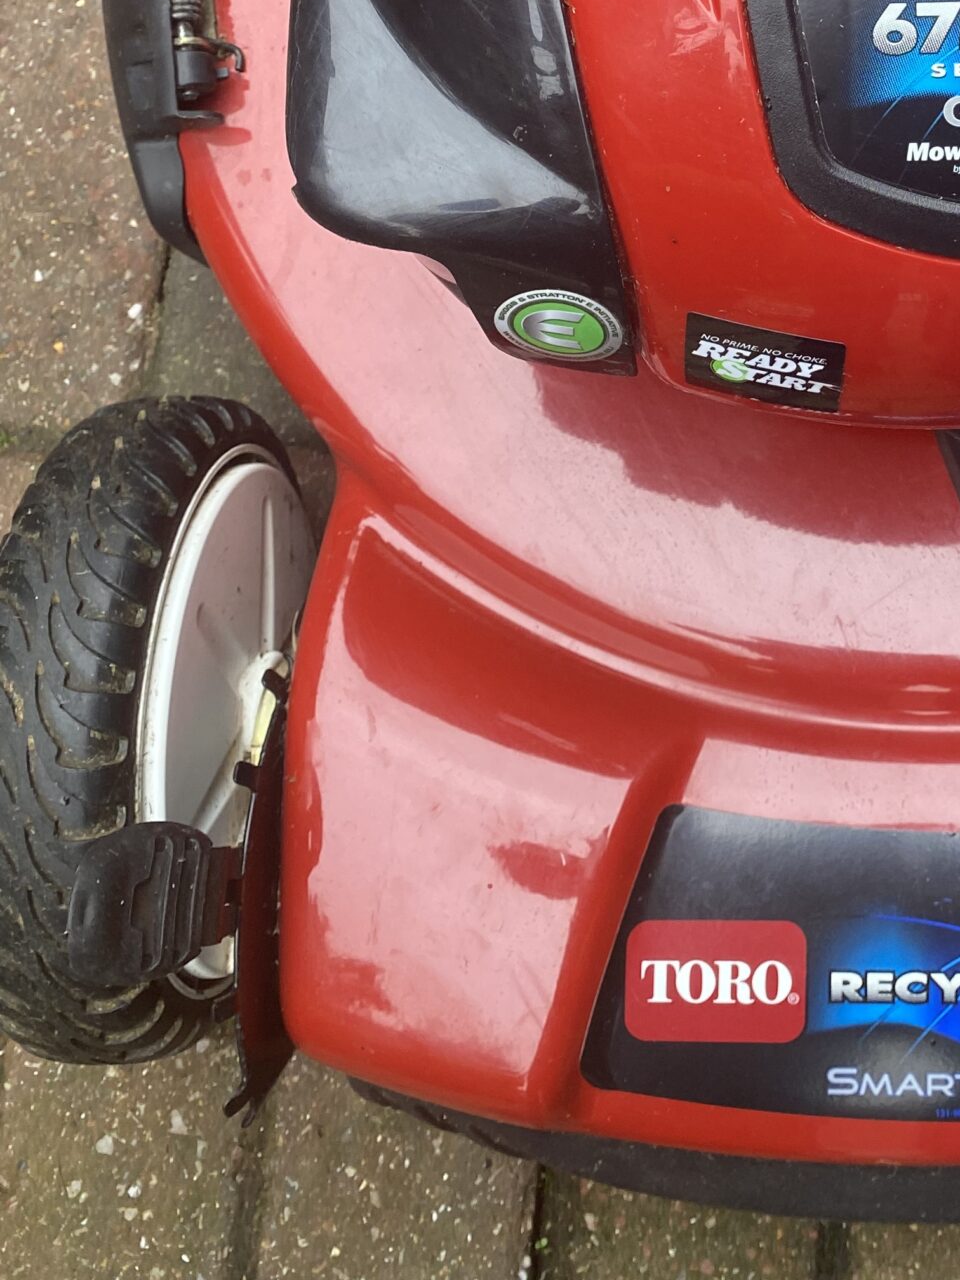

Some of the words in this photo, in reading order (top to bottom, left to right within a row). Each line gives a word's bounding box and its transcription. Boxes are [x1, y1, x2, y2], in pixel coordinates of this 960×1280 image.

[691, 339, 826, 379] READY
[700, 333, 720, 343] NO
[721, 338, 760, 353] PRIME.
[762, 347, 782, 357] NO
[784, 352, 828, 366] CHOKE.
[715, 359, 834, 394] START
